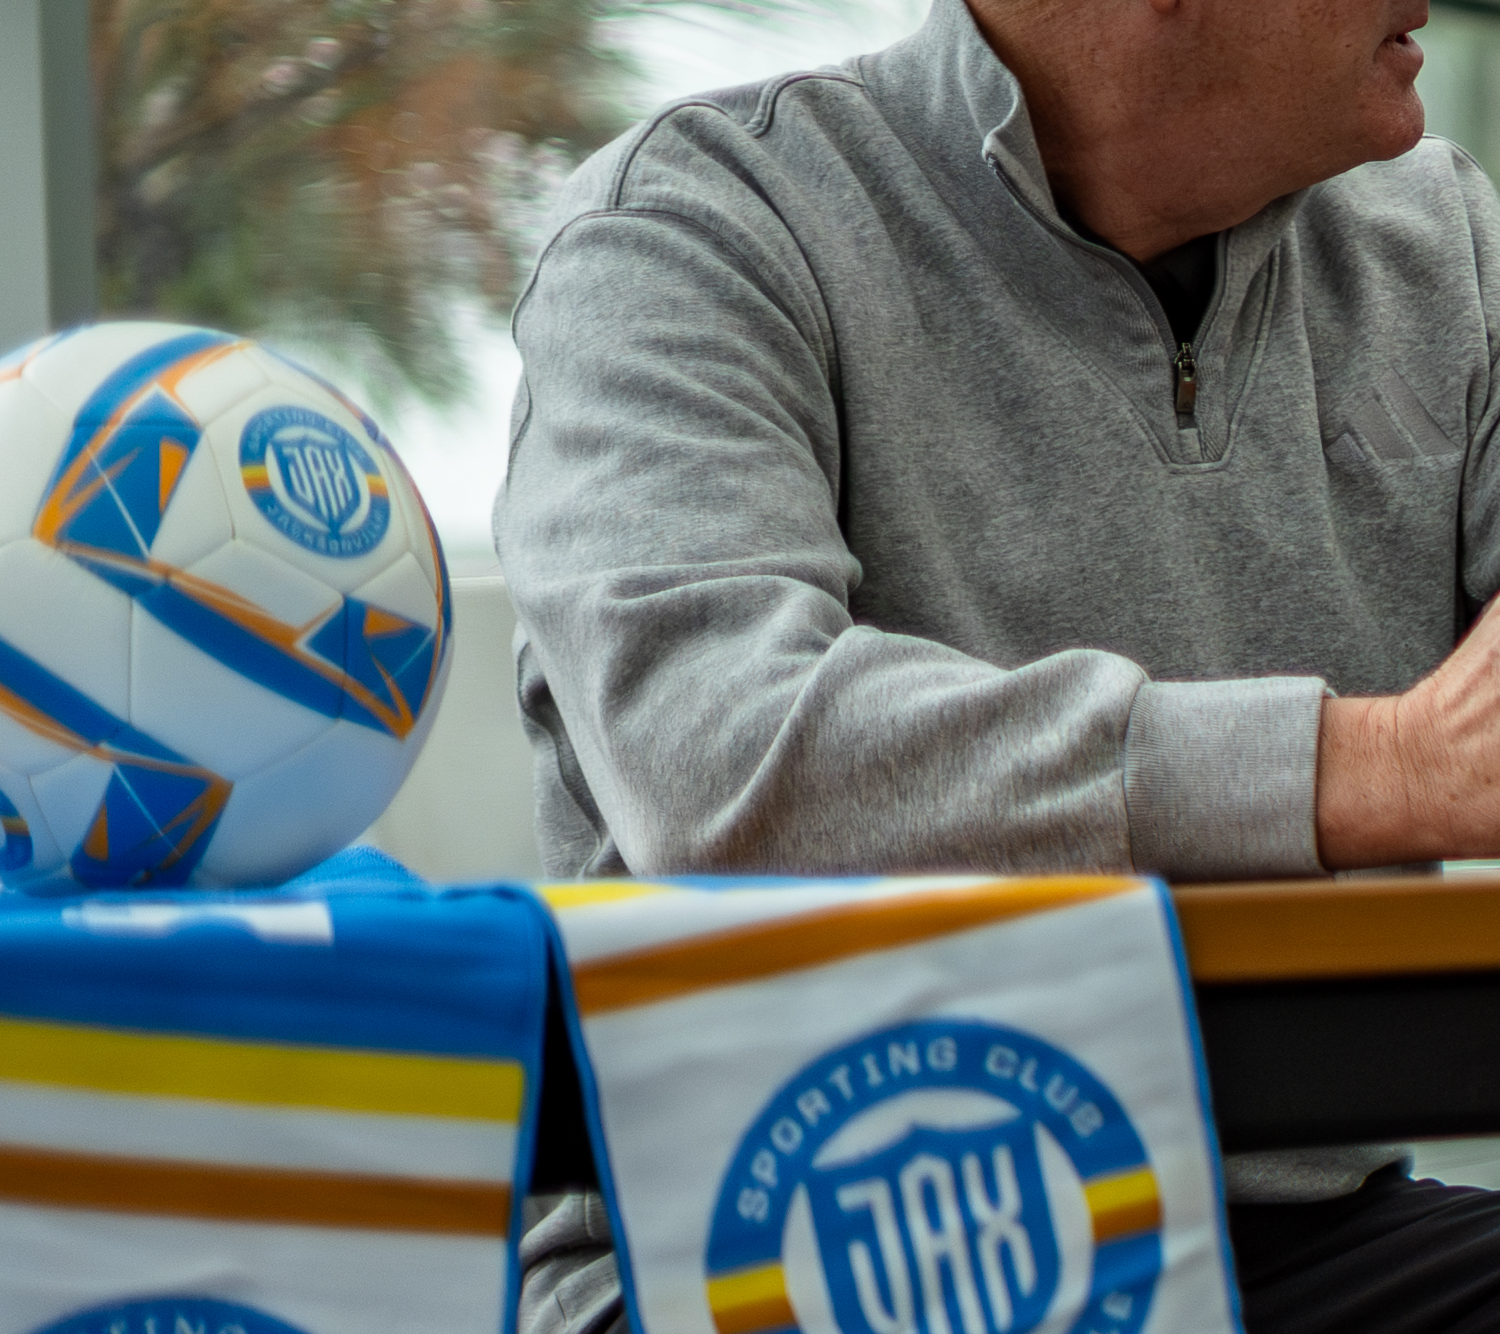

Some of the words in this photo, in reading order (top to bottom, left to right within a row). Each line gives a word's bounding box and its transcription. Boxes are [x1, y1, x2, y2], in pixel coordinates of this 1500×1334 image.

[282, 445, 353, 520] JAX
[738, 1036, 957, 1223] SPORTING
[985, 1045, 1103, 1137] CLUB
